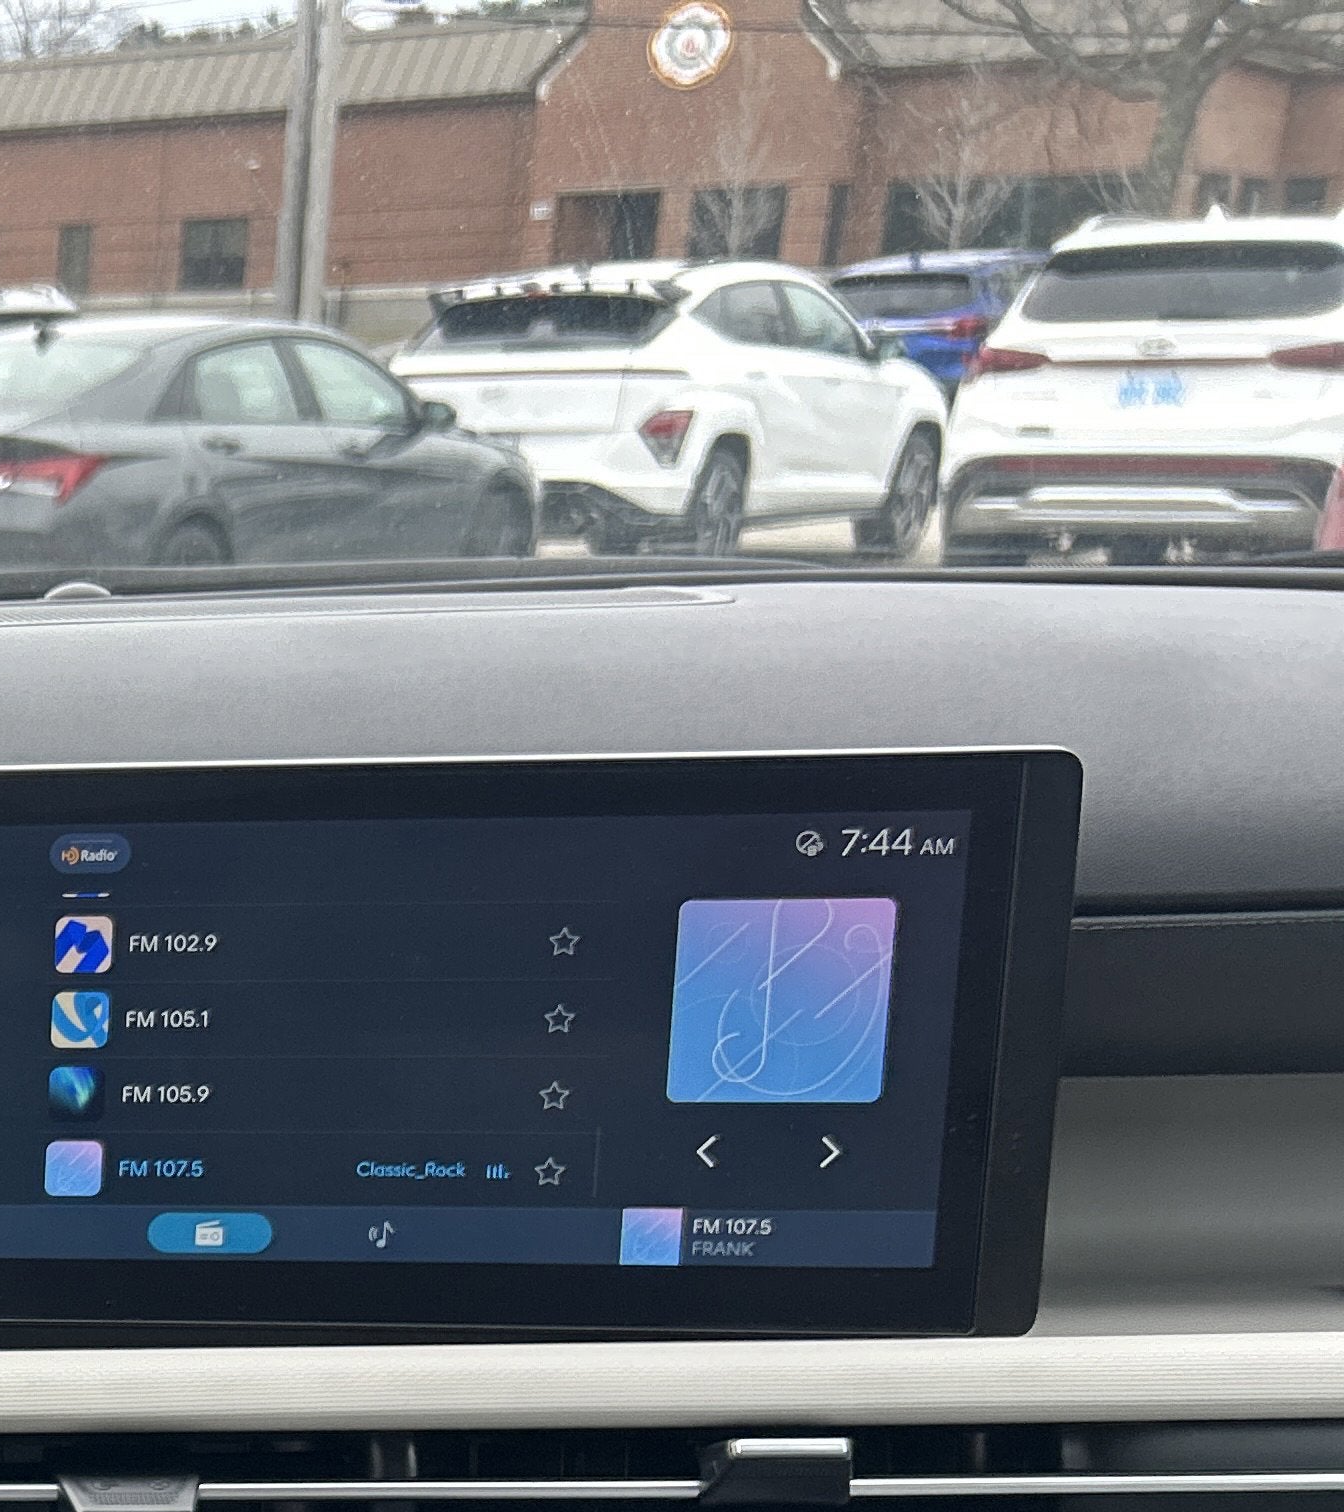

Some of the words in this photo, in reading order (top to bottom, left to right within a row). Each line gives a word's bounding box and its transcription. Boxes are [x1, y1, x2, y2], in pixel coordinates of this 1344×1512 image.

[839, 826, 915, 858] 7:44
[918, 841, 957, 857] AM
[128, 933, 158, 954] FM
[163, 932, 218, 955] 102.9
[124, 1009, 155, 1030] FM
[159, 1008, 211, 1030] 105.1
[120, 1084, 150, 1105] FM
[155, 1083, 211, 1106] 105.9
[118, 1158, 149, 1179] FM
[153, 1157, 205, 1180] 107.5
[355, 1158, 467, 1182] Classic_Rock
[692, 1217, 720, 1235] FM
[725, 1217, 773, 1236] 107.5
[691, 1240, 755, 1257] FRANK
